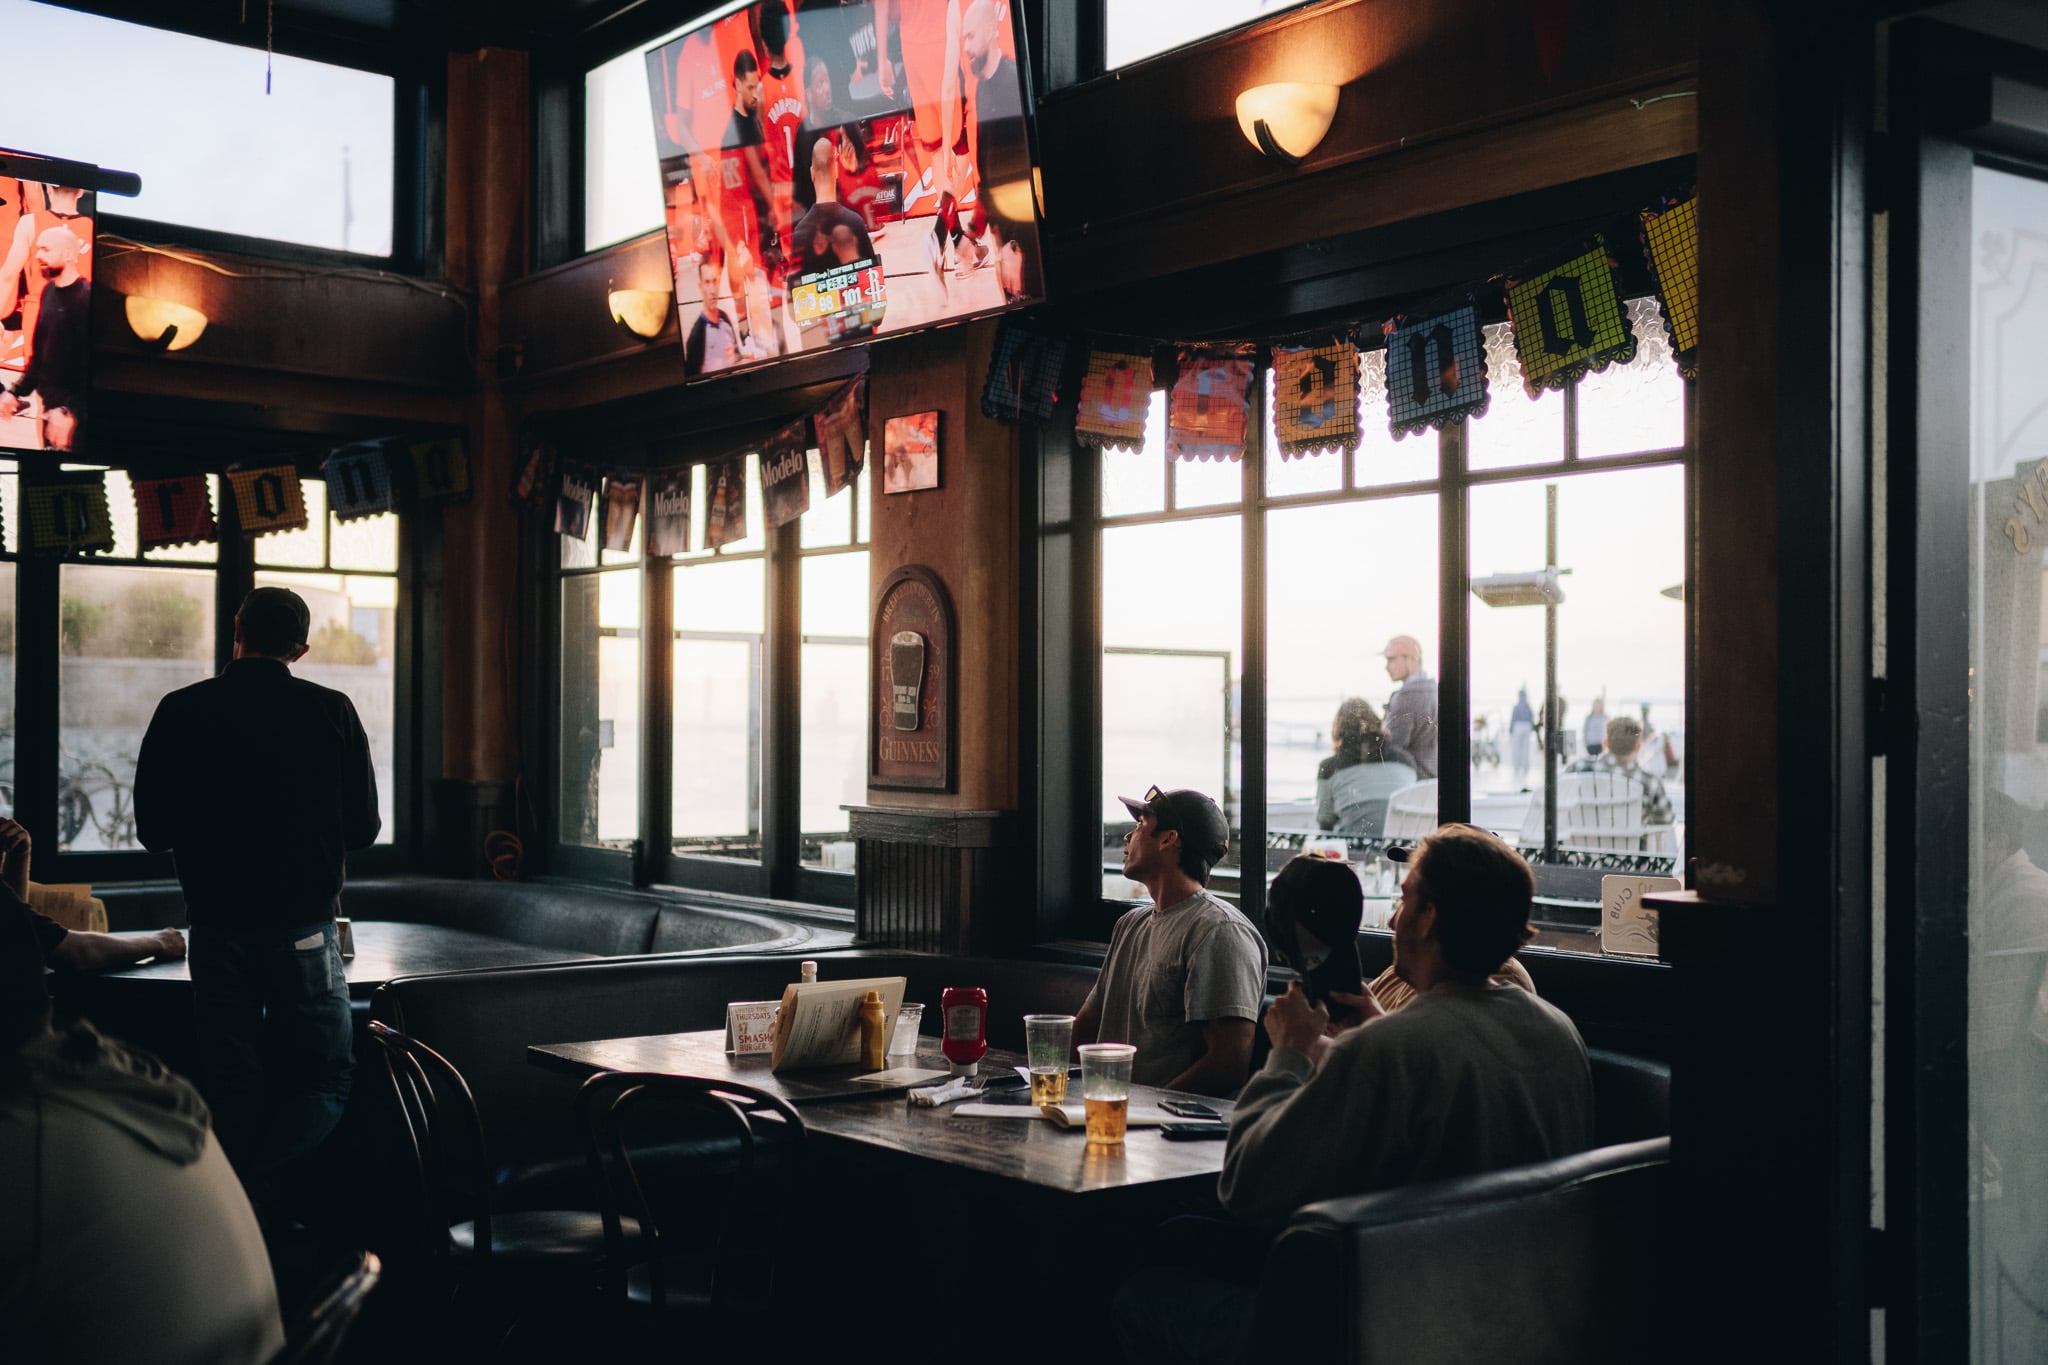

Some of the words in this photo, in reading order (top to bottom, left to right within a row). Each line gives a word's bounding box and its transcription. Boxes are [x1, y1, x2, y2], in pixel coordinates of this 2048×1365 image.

[842, 287, 862, 306] 101
[761, 447, 803, 490] Modelo
[562, 473, 592, 507] Modelo
[654, 490, 690, 518] Modelo
[879, 735, 940, 763] GUINNESS
[736, 1012, 771, 1021] THURSDAYS
[738, 1034, 770, 1044] SMASH
[739, 1043, 766, 1052] BURGER
